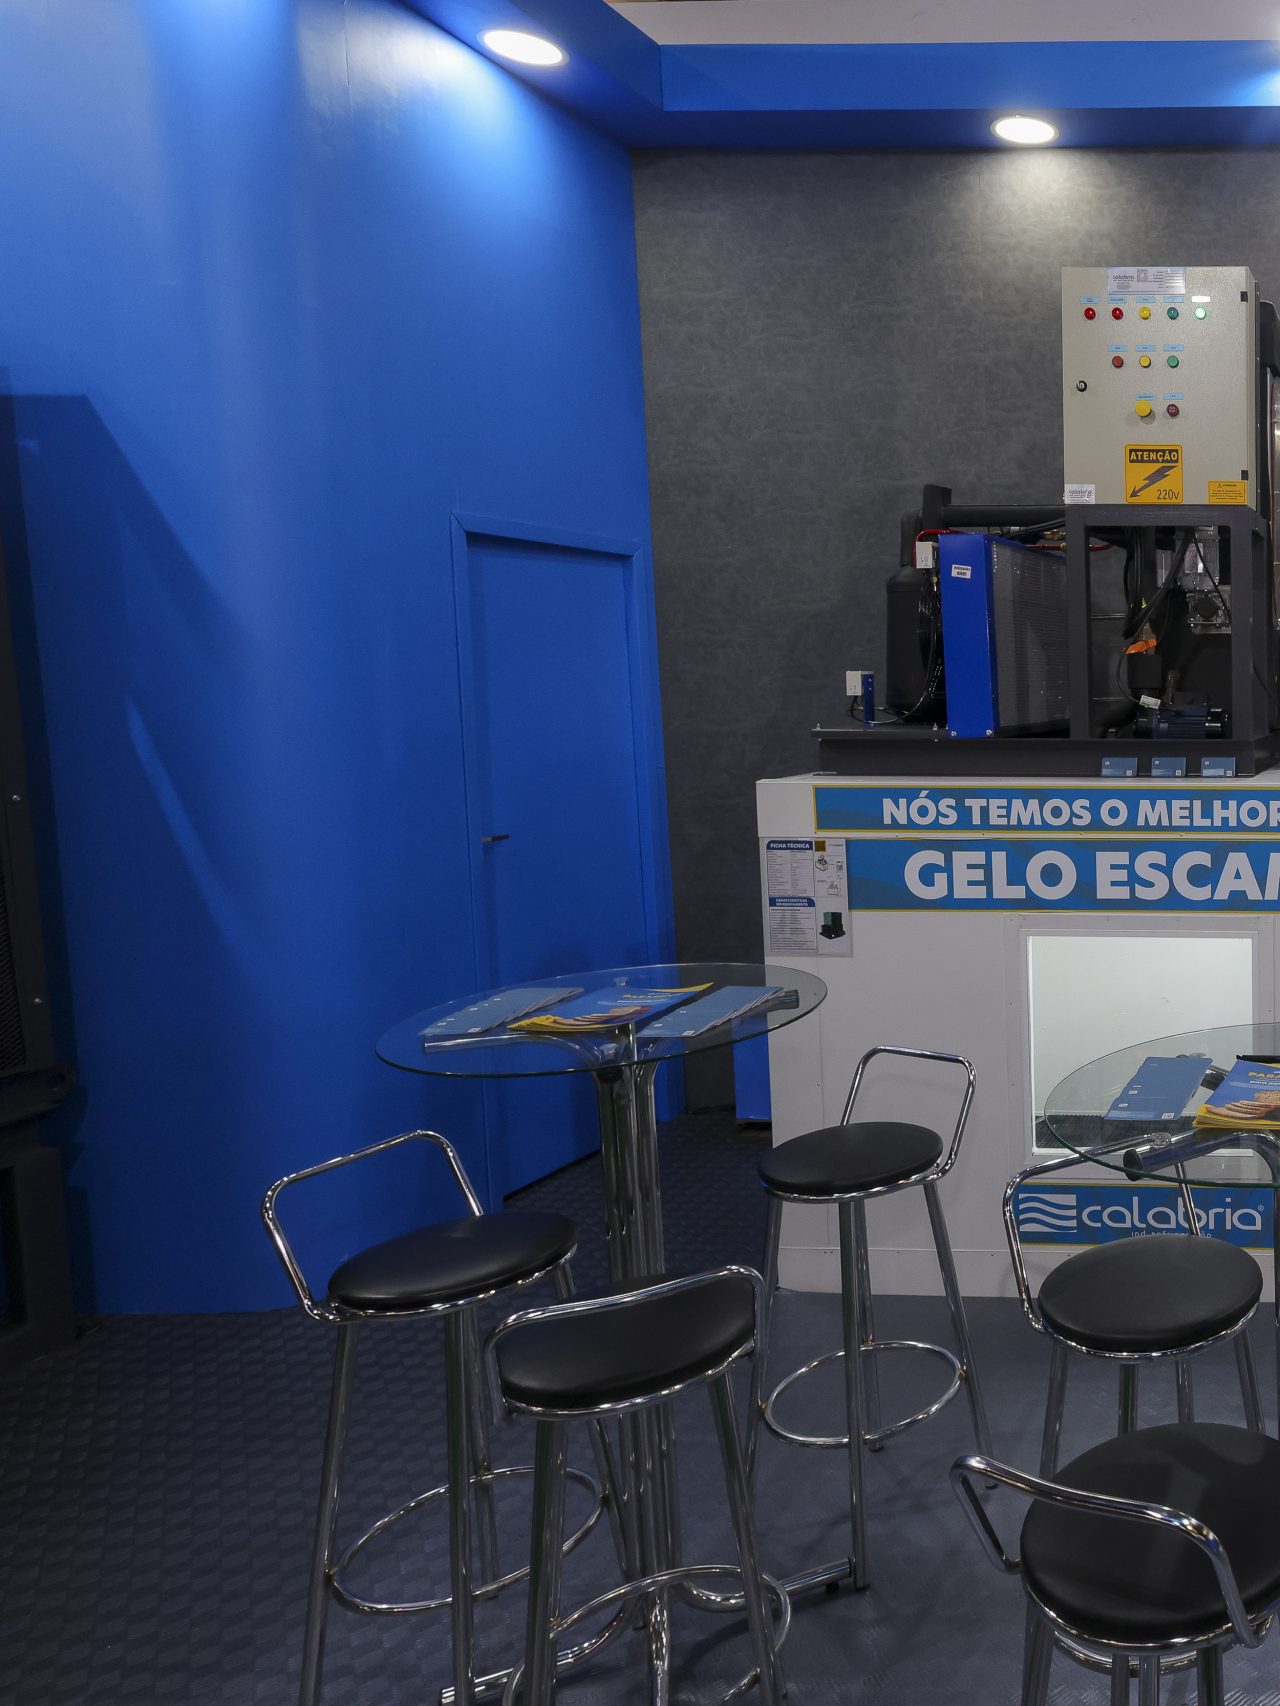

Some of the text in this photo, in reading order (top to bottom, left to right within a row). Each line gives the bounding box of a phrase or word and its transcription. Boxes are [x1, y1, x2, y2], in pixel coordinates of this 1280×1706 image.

[1130, 450, 1178, 463] ATENÇÃO
[1156, 489, 1180, 501] 220v
[882, 791, 956, 827] NÓS
[964, 798, 1091, 827] TEMOS
[1101, 798, 1129, 827] O
[904, 850, 1077, 900] GELO
